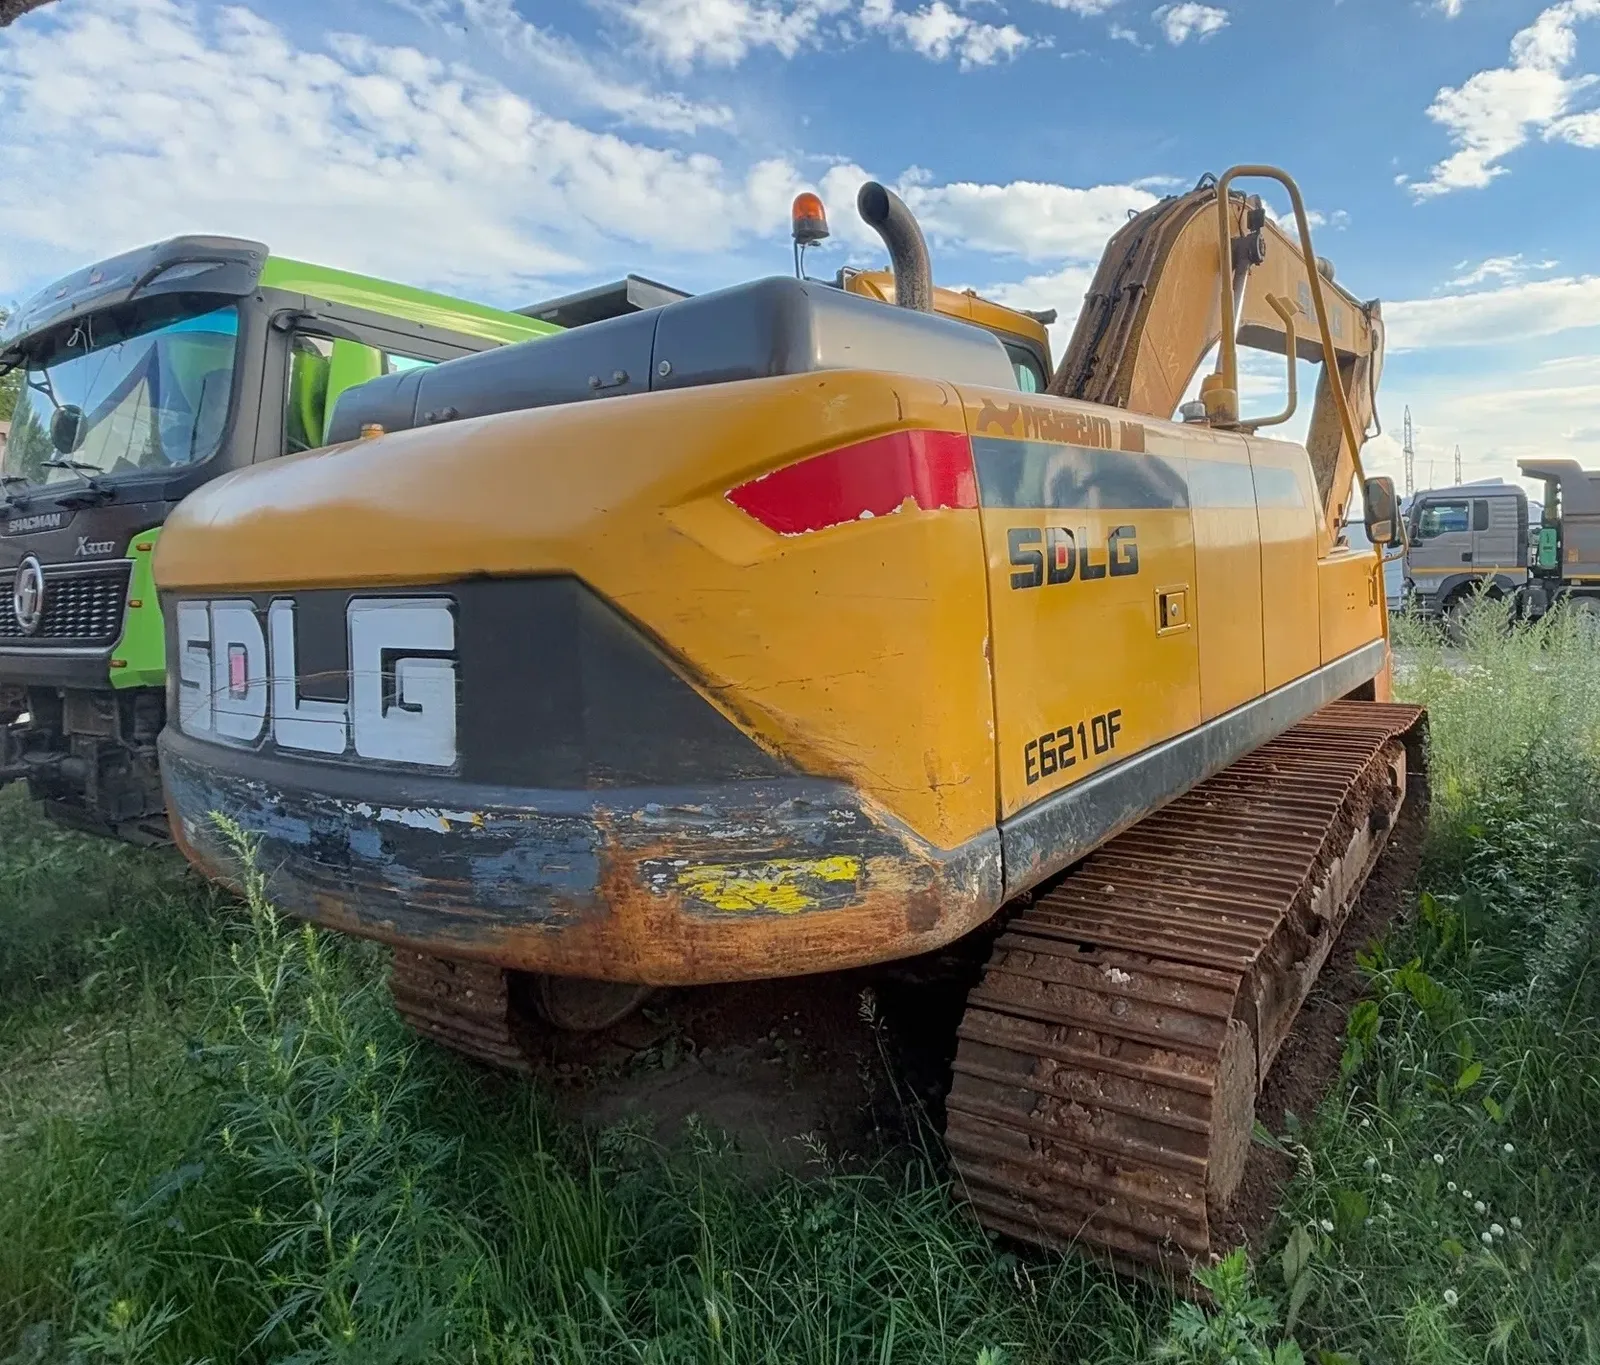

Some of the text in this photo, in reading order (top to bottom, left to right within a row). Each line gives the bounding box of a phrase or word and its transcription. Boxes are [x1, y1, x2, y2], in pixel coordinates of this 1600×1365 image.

[9, 514, 61, 532] SHACMAN
[1007, 525, 1139, 590] SDLG
[177, 599, 457, 767] SDLG
[1025, 709, 1121, 785] E6210F
